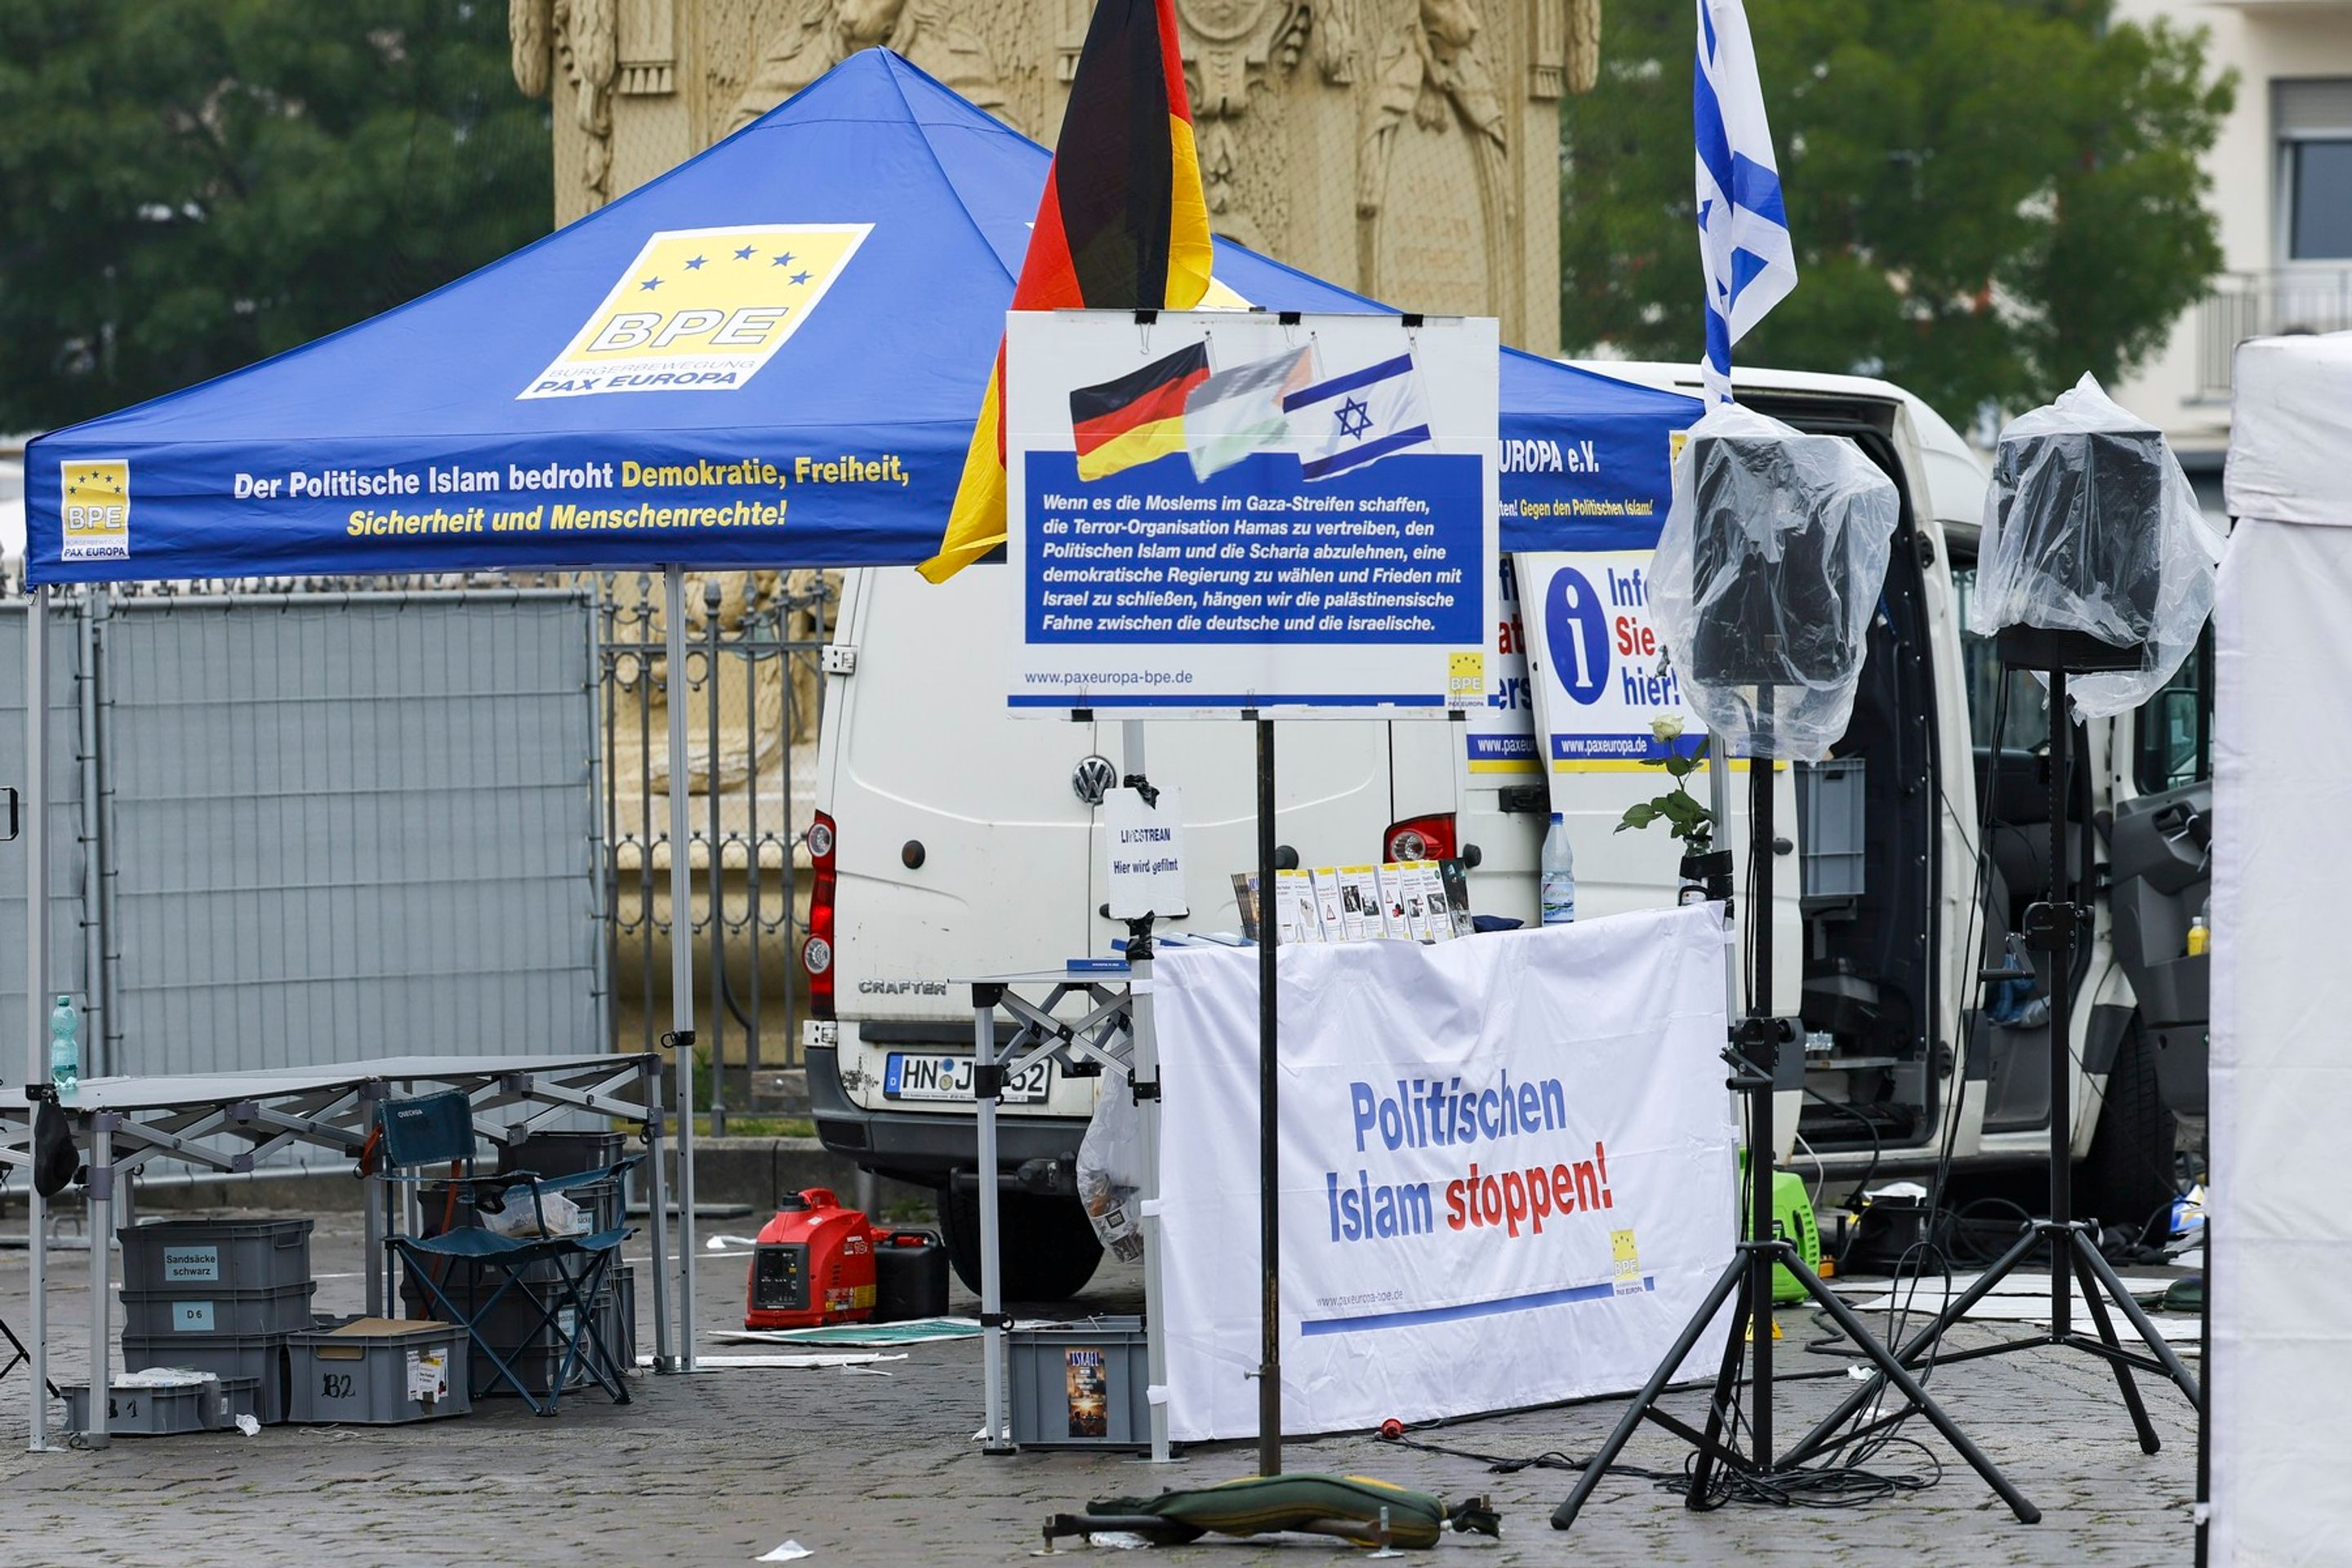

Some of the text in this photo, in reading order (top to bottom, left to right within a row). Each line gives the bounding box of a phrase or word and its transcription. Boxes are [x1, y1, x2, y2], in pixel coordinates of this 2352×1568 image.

[586, 307, 789, 352] BPE
[532, 372, 737, 393] PAX EUROPA
[1499, 439, 1599, 473] UROPA e.V.
[234, 455, 909, 499] Der Politische Islam bedroht Demokratie, Freiheit,
[1044, 494, 1430, 515] Wenn es die Moslems im Gaza-Streifen schaffen,
[1499, 499, 1518, 517] ten!
[1520, 498, 1551, 520] Gegen
[1553, 500, 1570, 516] den
[1572, 499, 1624, 516] Politischen
[69, 506, 123, 530] BPE
[347, 500, 787, 537] Sicherheit und Menschenrechte!
[1043, 519, 1435, 538] die Terror-Organisation Hamas zu vertreiben, den
[65, 547, 126, 557] PAX EUROPA
[1042, 542, 1446, 563] Politischen Islam und die Scharia abzulehnen, eine
[1043, 566, 1463, 586] demokratische Regierung zu wählen und Frieden mit
[1607, 568, 1649, 607] Inf
[1042, 590, 1454, 610] Israel zu schließen, hängen wir die palästinensische
[1042, 614, 1435, 630] Fahne zwischen die deutsche und die israelische.
[1615, 616, 1655, 656] Sie
[1025, 670, 1193, 686] www.paxeuropa-bpe.de
[1450, 676, 1481, 690] BPE
[1621, 666, 1681, 706] hier!
[1477, 738, 1537, 755] www.paxeur
[1561, 737, 1648, 756] www.paxeuropa.de
[1113, 858, 1178, 875] Hier wird gefilmt
[858, 980, 947, 996] CRAFTER
[902, 1059, 938, 1089] HN
[1350, 1068, 1567, 1152] Politischen
[1325, 1141, 1614, 1242] Islam stoppen!
[166, 1254, 216, 1264] Sandsäcke
[172, 1267, 212, 1276] schwarz
[186, 1310, 203, 1319] D 6
[321, 1373, 356, 1399] B2
